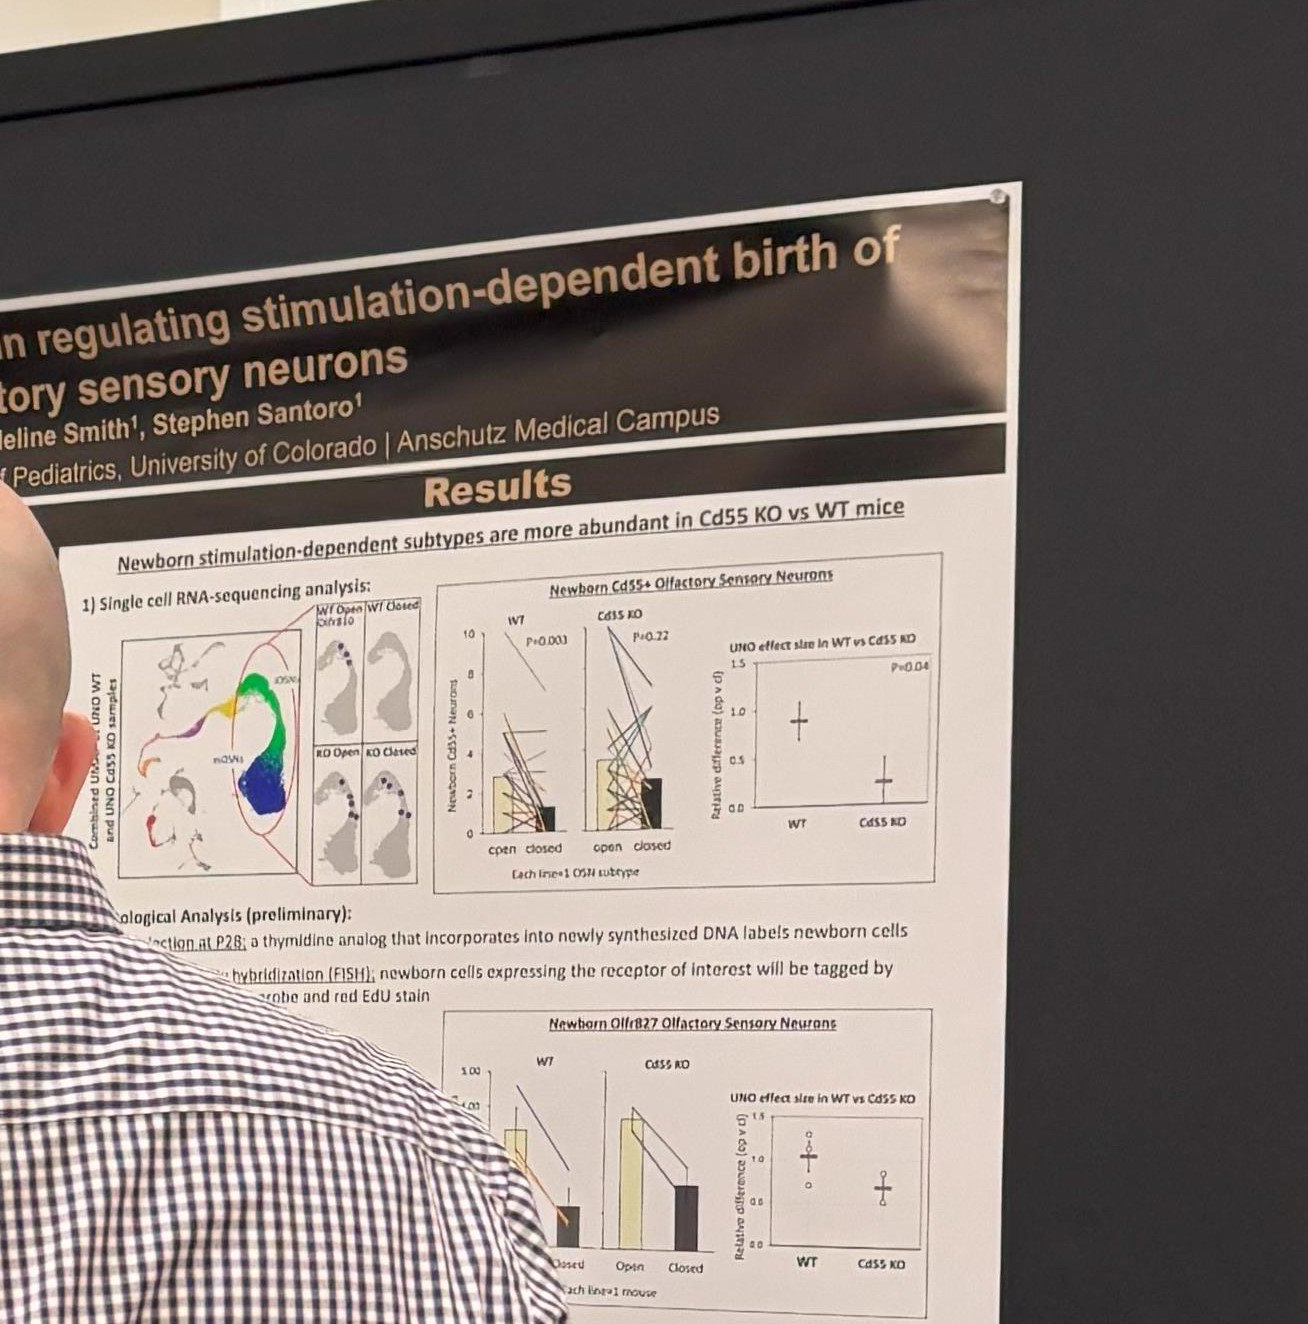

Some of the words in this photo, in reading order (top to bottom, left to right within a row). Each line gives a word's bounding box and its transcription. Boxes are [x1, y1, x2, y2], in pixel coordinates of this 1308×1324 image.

[35, 307, 231, 361] regulating
[240, 246, 719, 335] stimulation-dependent
[731, 231, 838, 282] birth
[853, 225, 902, 269] of
[77, 362, 231, 410] sensory
[242, 341, 408, 389] neurons
[151, 406, 250, 438] Stephen
[14, 459, 122, 494] Pediatrics,
[129, 446, 238, 478] University
[243, 441, 268, 467] of
[271, 433, 377, 465] Colorado
[395, 422, 507, 454] Anschutz
[513, 409, 608, 443] Medical
[615, 405, 721, 434] Campus
[423, 467, 572, 509] Results
[116, 551, 198, 575] Newborn
[195, 534, 402, 569] stimulation-dependent
[400, 529, 489, 553] subtypes
[486, 527, 523, 546] are
[520, 522, 577, 543] more
[575, 513, 674, 539] abundant
[672, 510, 697, 532] in
[698, 506, 749, 527] Cd55
[753, 504, 783, 524] KO
[787, 505, 810, 521] vs
[814, 499, 850, 520] WT
[854, 496, 905, 517] mice
[81, 595, 96, 615] 1)
[98, 593, 144, 613] Single
[146, 590, 173, 608] cell
[175, 582, 302, 606] RNA-sequencing
[304, 576, 371, 598] analysis:
[120, 909, 176, 927] ological
[179, 906, 242, 927] Analysis
[245, 903, 352, 926] (preliminary):
[198, 936, 212, 949] at
[249, 936, 259, 948] a
[261, 931, 334, 951] thymidine
[337, 930, 388, 949] analog
[390, 929, 421, 946] that
[424, 929, 520, 948] incorporates
[523, 928, 554, 944] into
[557, 926, 604, 946] newly
[607, 924, 699, 946] synthesized
[702, 924, 739, 941] DNA
[742, 923, 790, 941] labels
[792, 922, 867, 940] newborn
[870, 921, 908, 939] cells
[548, 1016, 608, 1029] Newborn
[660, 1015, 722, 1029] Olfactory
[723, 1015, 778, 1030] Sensory
[779, 1015, 837, 1030] Neurons
